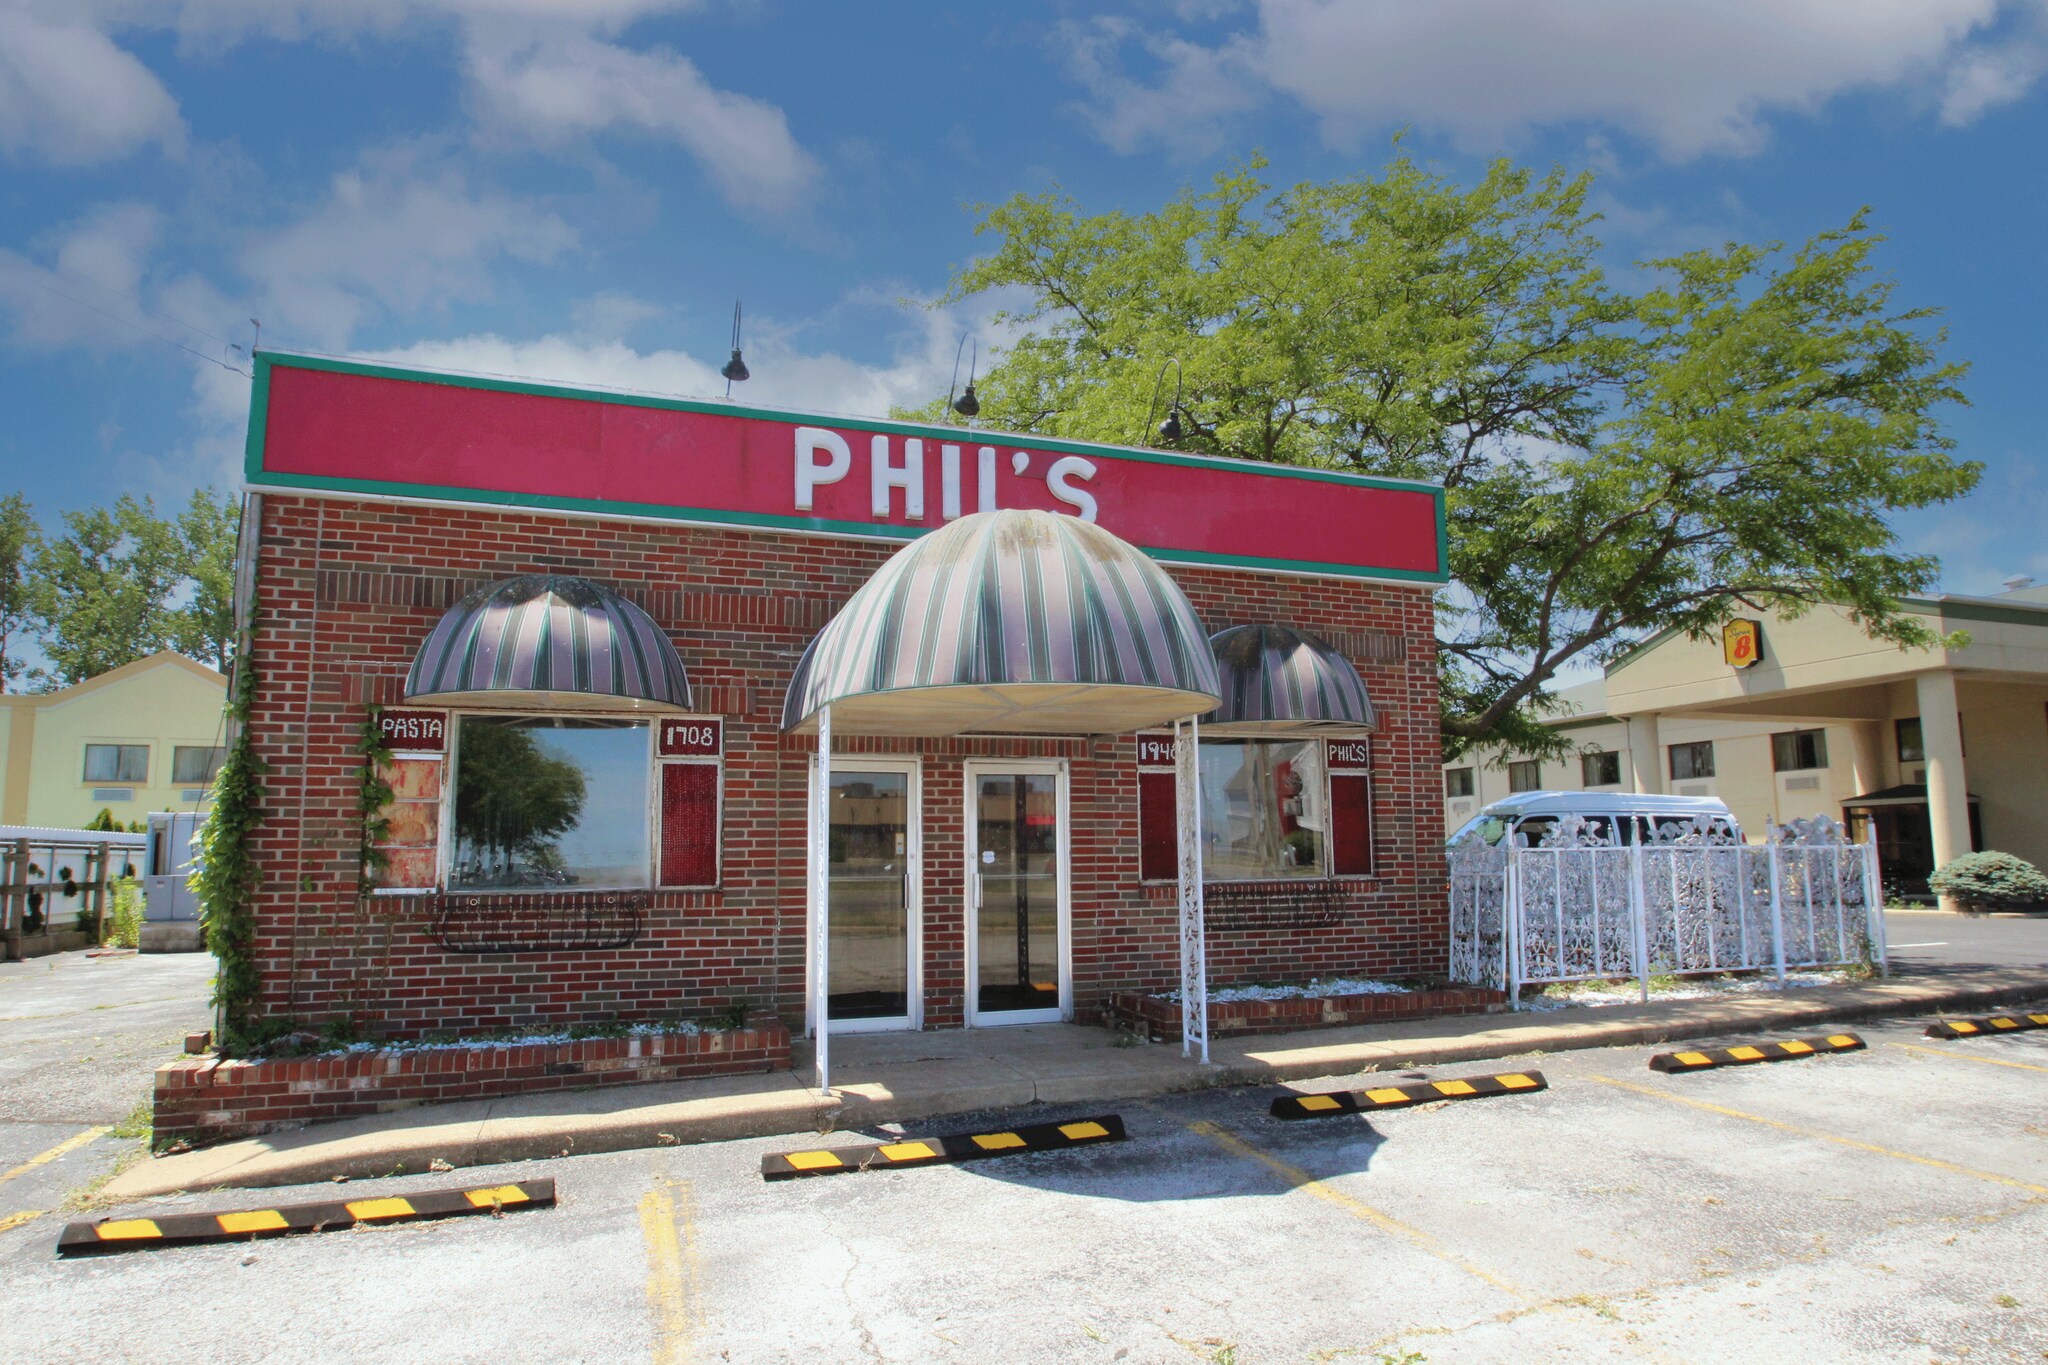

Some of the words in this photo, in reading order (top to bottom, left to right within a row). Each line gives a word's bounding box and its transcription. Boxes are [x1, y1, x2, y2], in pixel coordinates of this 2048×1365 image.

[1734, 635, 1751, 659] 8
[382, 718, 442, 738] PASTA
[667, 726, 713, 746] 1708
[1329, 743, 1366, 762] PHIL'S
